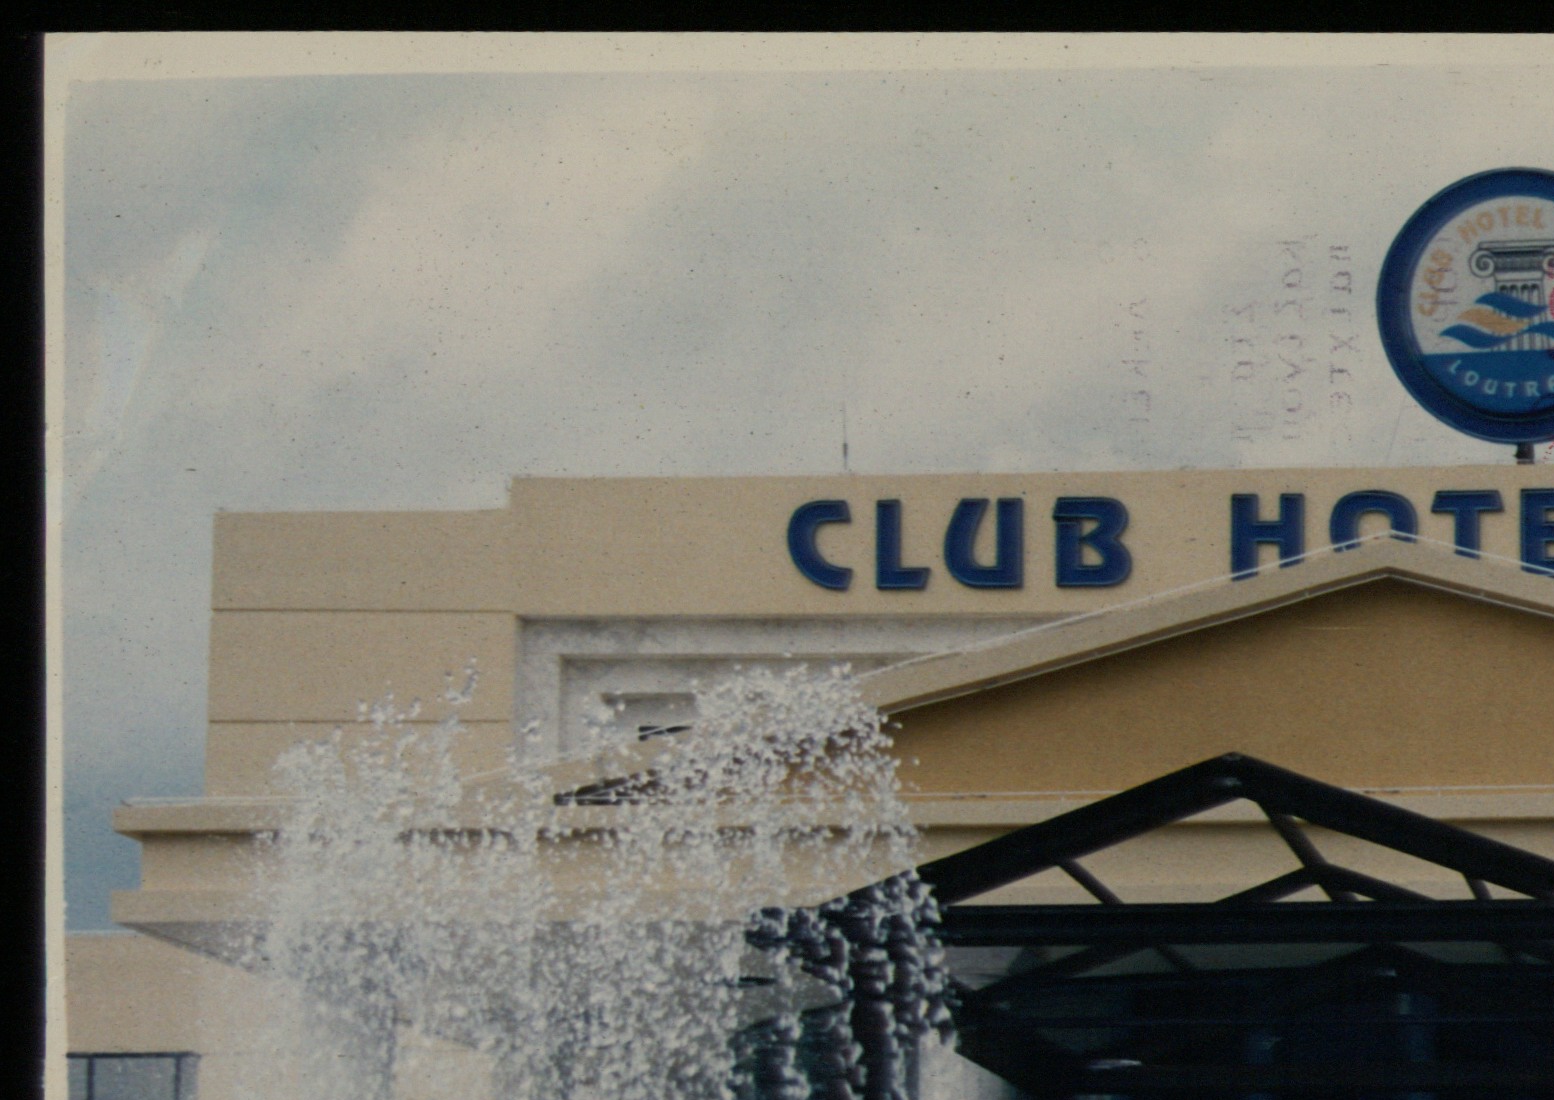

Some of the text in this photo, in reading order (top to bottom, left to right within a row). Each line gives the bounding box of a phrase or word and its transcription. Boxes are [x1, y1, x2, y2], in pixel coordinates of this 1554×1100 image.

[1416, 248, 1454, 317] CLUB
[1457, 205, 1544, 244] HOTEL
[787, 496, 1133, 591] CLUB
